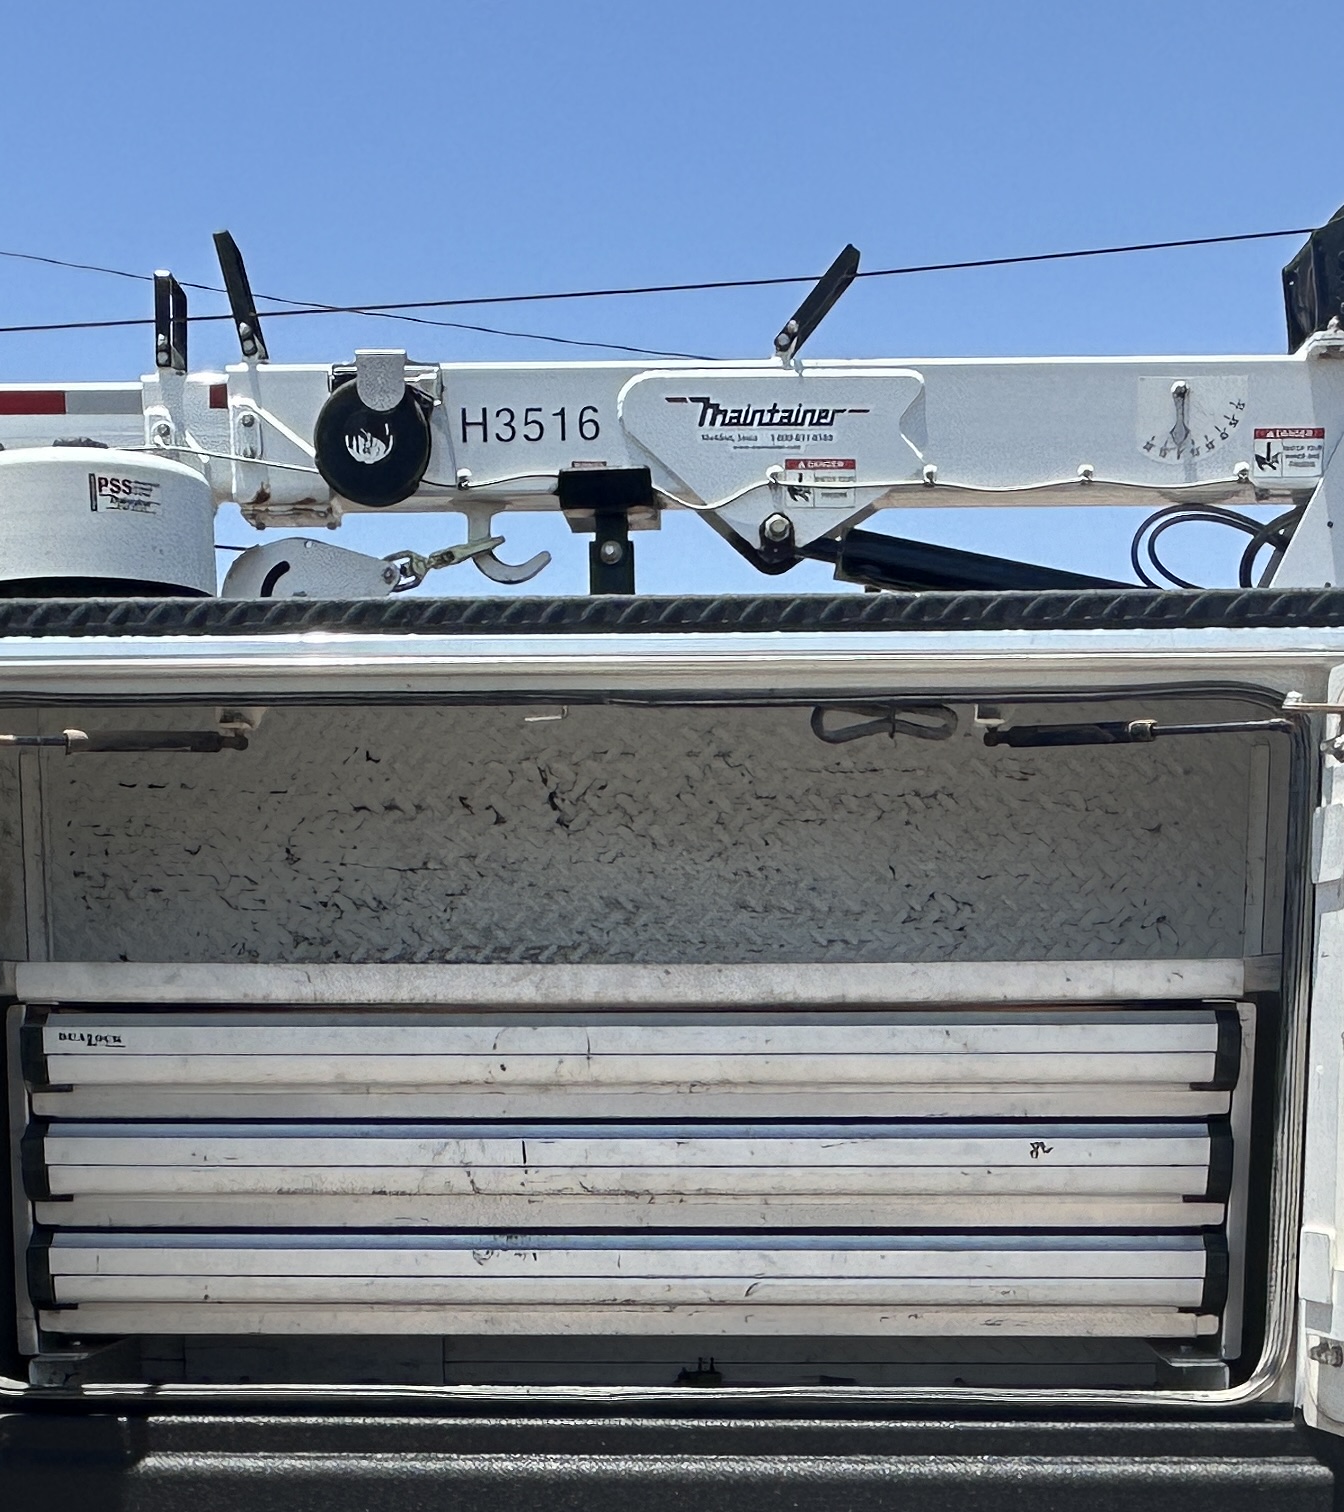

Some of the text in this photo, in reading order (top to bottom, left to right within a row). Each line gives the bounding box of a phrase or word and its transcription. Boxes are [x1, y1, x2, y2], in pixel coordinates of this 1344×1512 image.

[459, 405, 601, 444] H3516
[689, 397, 847, 427] Maintainer
[97, 476, 133, 496] PSS
